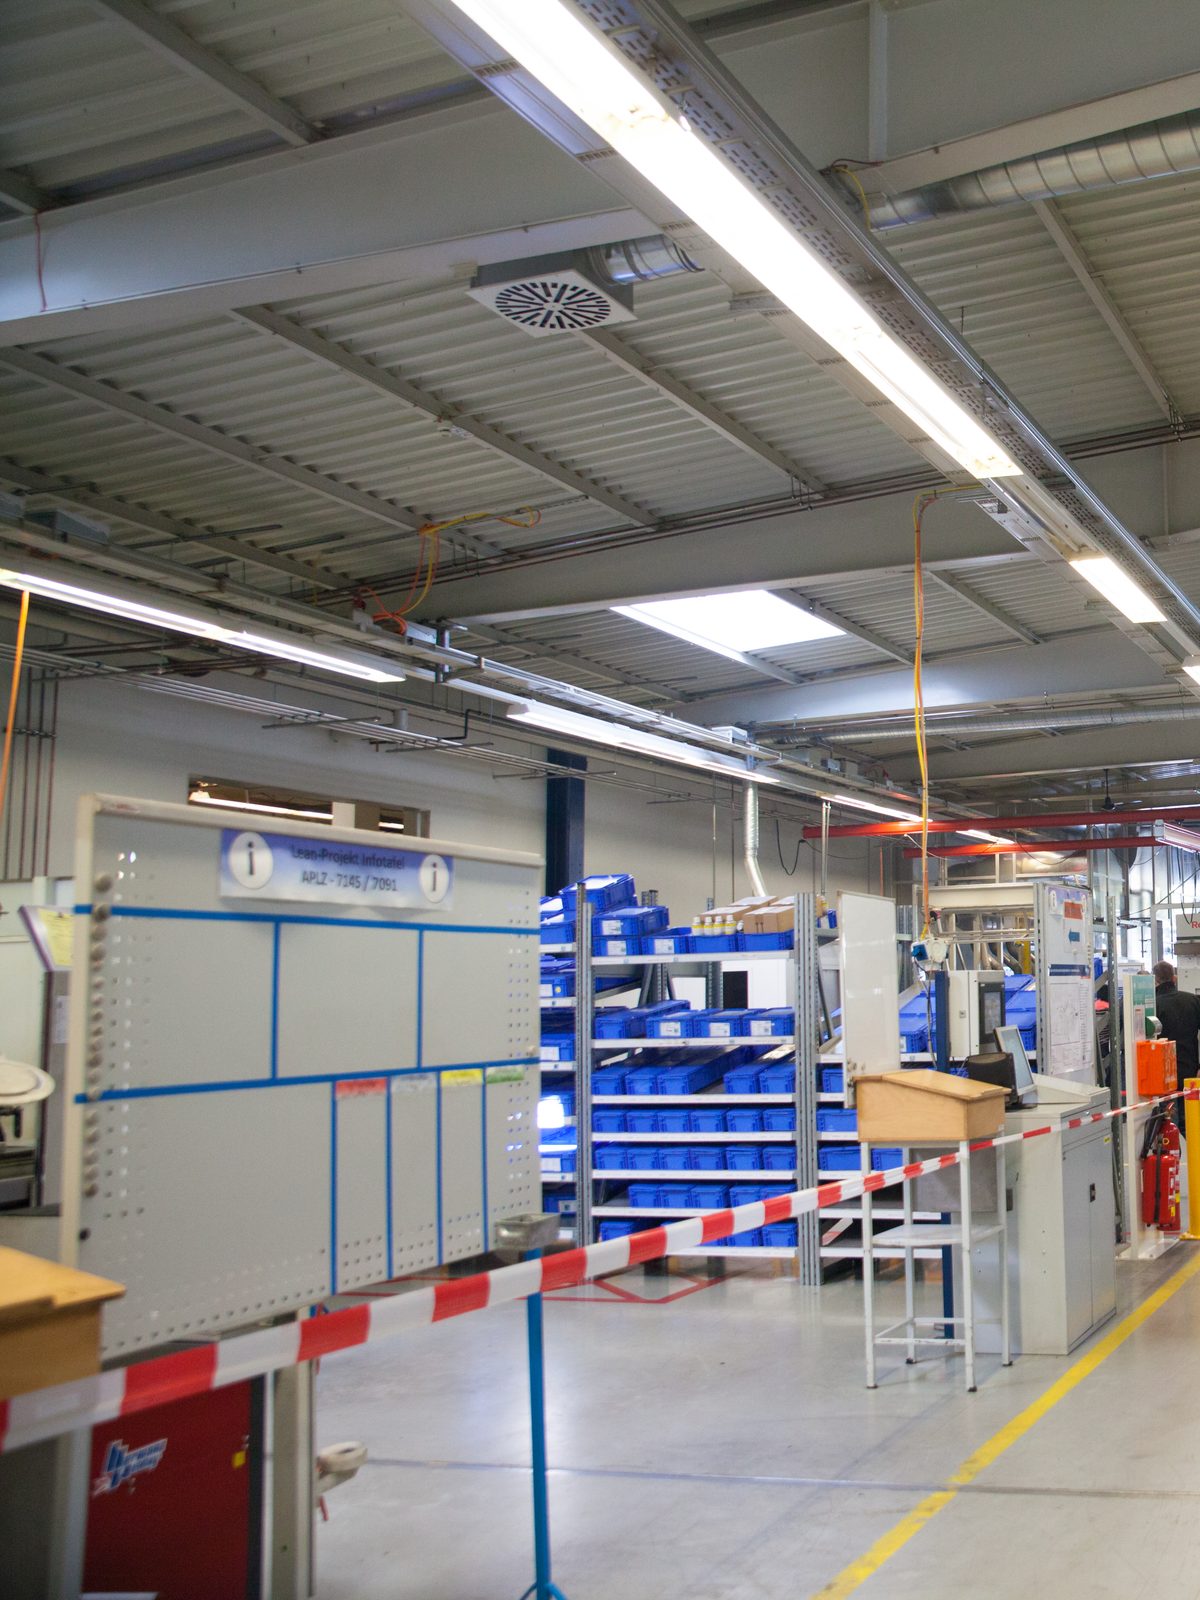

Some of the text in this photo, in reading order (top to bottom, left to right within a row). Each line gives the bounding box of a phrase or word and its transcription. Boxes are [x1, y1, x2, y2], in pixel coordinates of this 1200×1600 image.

[291, 845, 406, 870] Lean-Projekt Infotafel
[302, 869, 328, 886] APLZ
[337, 873, 361, 891] 7145
[373, 876, 398, 892] 7091
